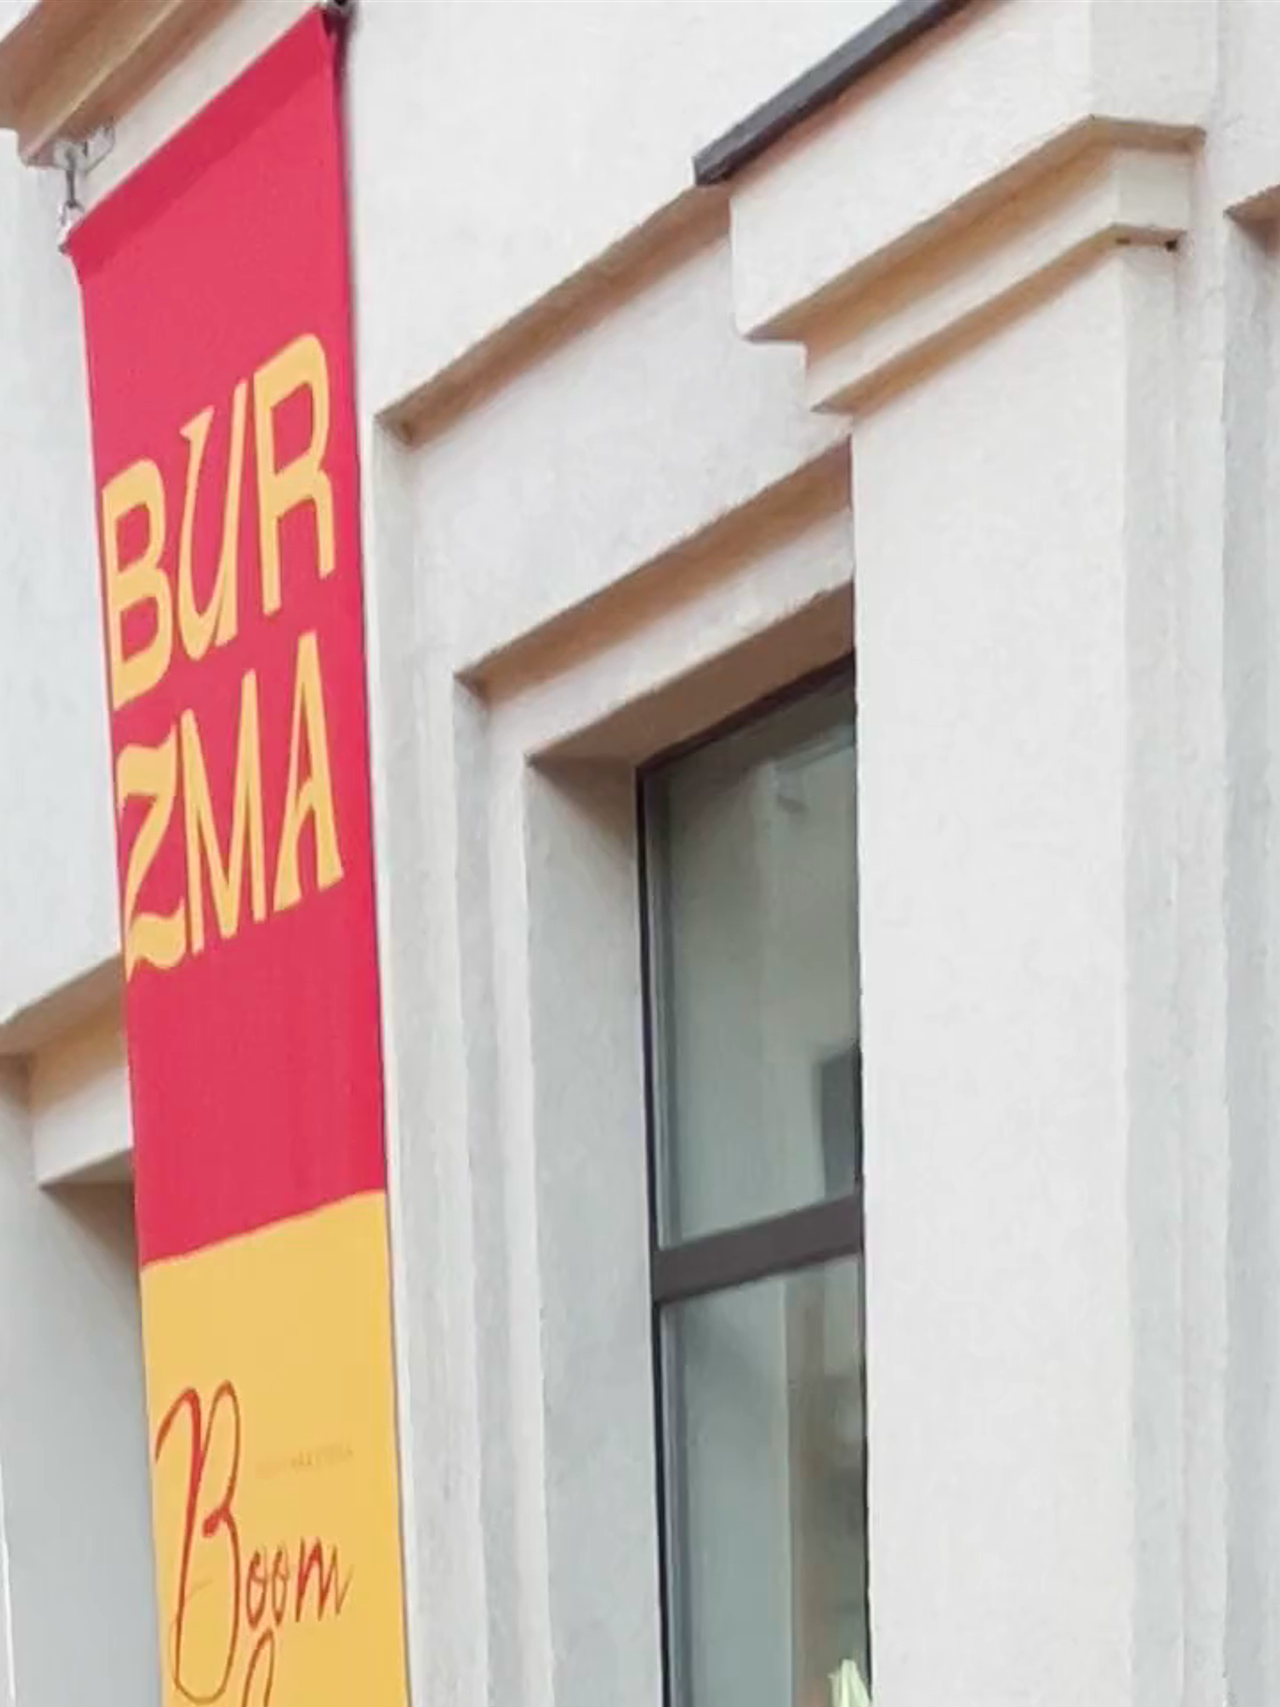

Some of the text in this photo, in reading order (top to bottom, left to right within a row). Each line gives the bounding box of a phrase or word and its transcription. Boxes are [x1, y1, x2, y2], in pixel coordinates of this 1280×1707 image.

[101, 331, 337, 712] BUR
[115, 629, 345, 983] ZMA
[154, 1379, 352, 1706] Boom
